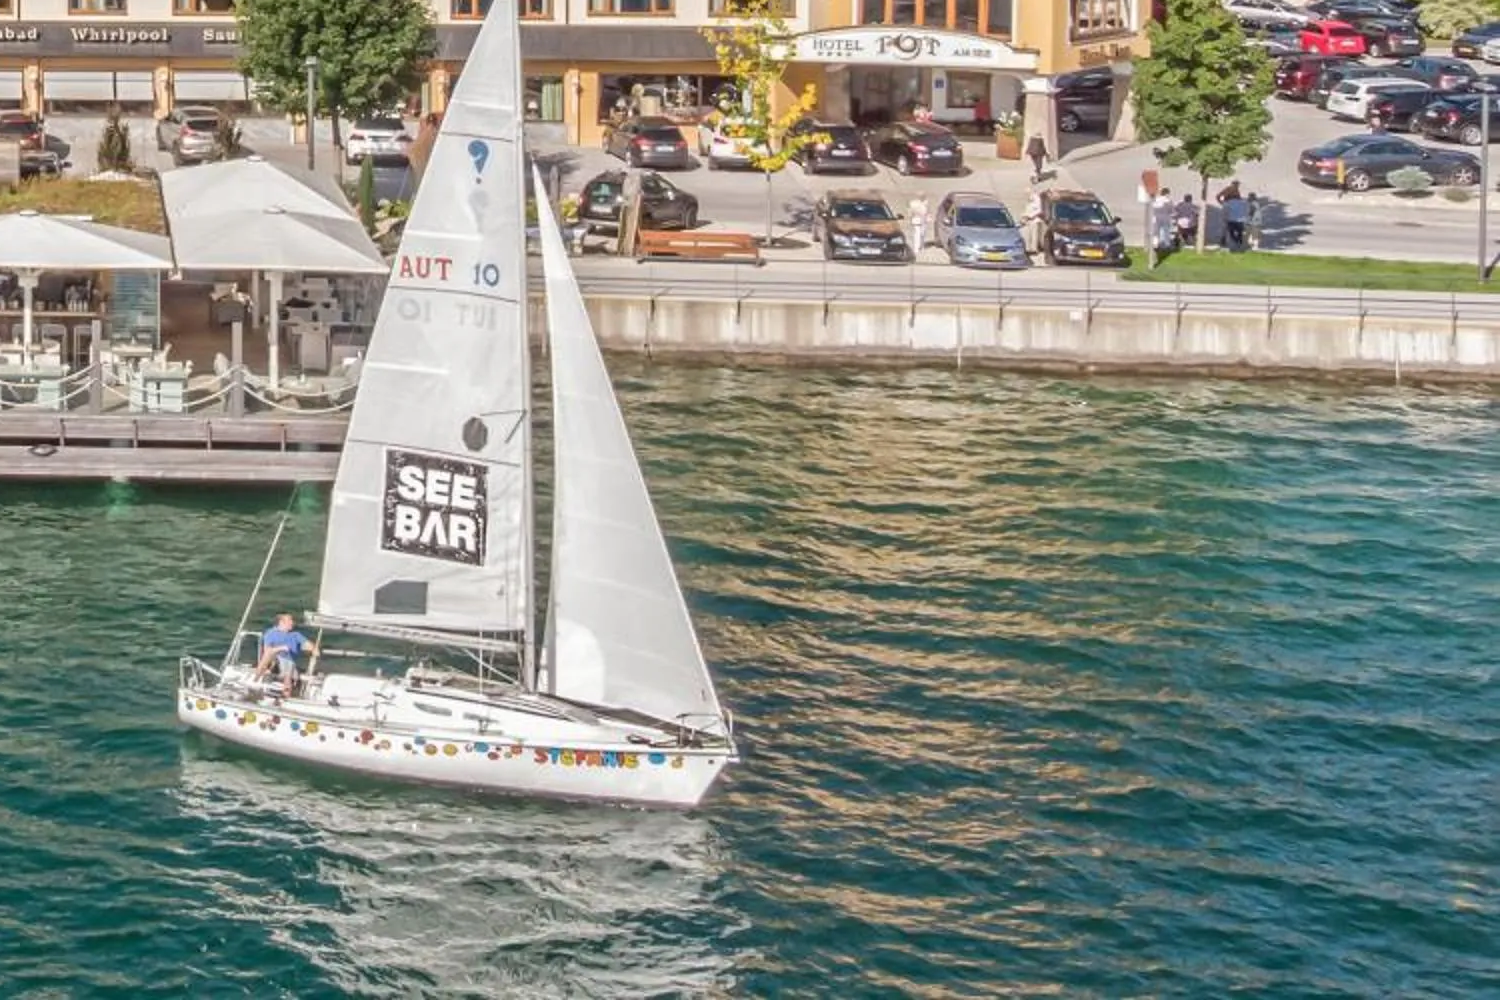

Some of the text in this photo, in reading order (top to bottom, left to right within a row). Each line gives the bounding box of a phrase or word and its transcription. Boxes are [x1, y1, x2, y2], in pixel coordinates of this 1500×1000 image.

[71, 27, 168, 42] Whirlpool
[813, 38, 864, 52] HOTEL
[399, 255, 500, 287] AUT 10
[397, 465, 478, 511] SEE
[395, 504, 477, 553] BAR
